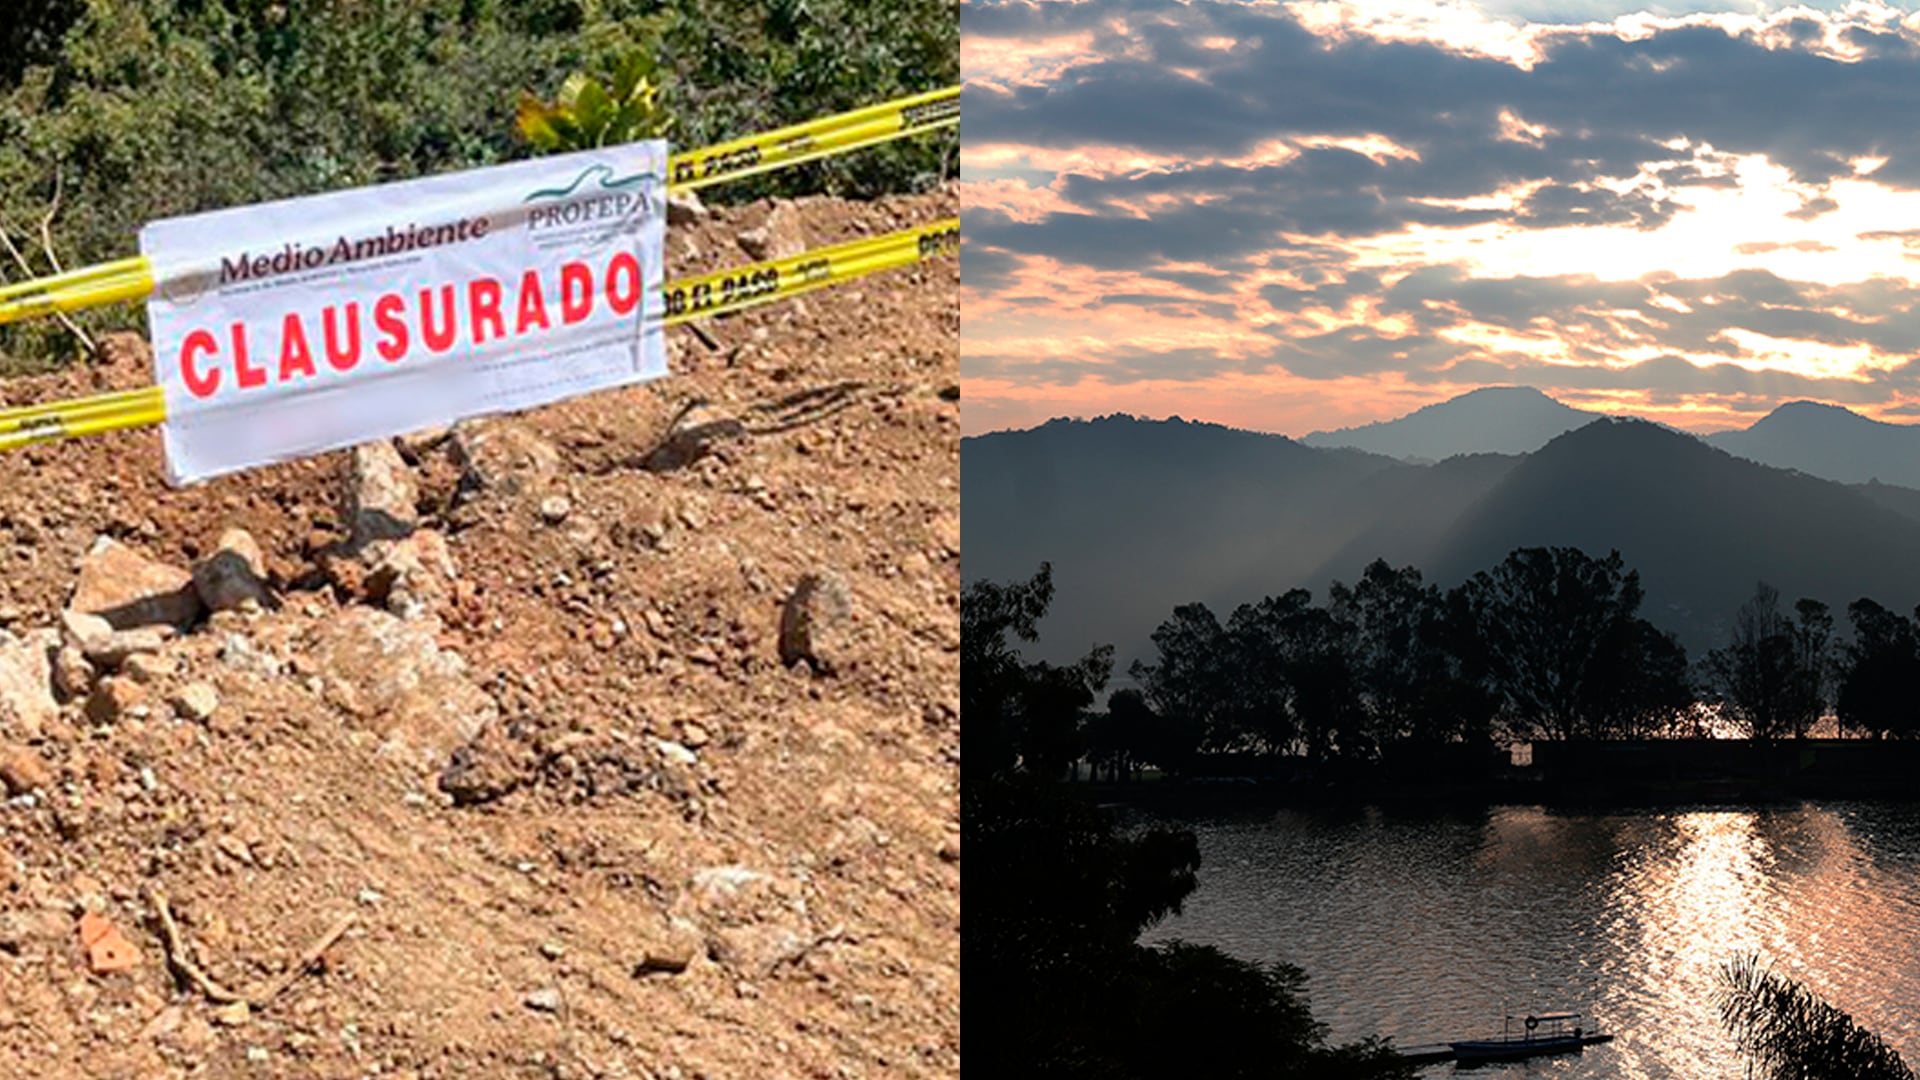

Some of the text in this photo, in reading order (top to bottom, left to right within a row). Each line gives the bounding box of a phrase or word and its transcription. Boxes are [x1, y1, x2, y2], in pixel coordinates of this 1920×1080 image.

[527, 192, 651, 230] PROFEPA
[219, 243, 325, 283] Medio
[327, 216, 489, 264] Ambiente
[180, 252, 643, 398] CLAUSURADO
